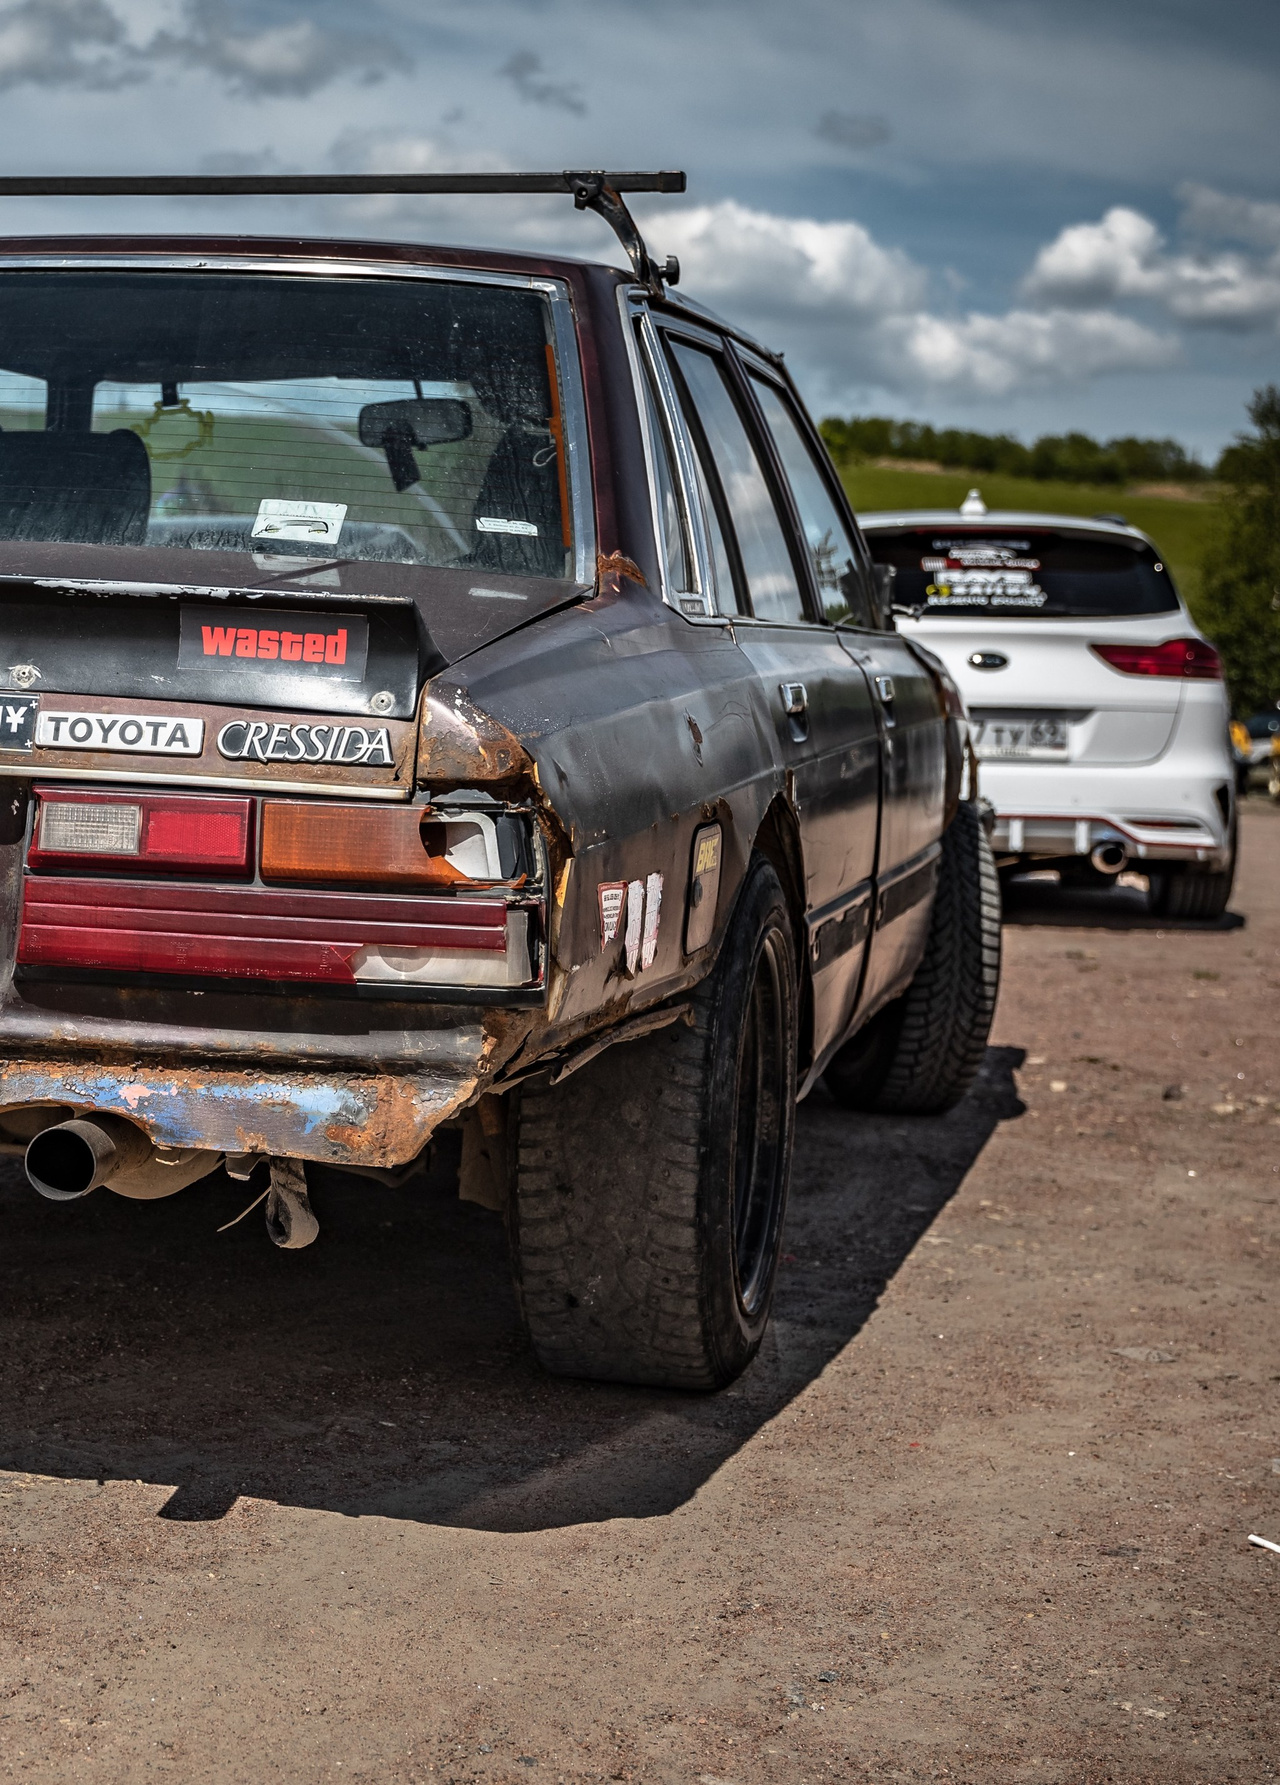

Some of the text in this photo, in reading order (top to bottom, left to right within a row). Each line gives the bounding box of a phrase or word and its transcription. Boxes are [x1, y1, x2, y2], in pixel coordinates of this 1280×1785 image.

[201, 625, 347, 664] Wasted
[47, 716, 191, 748] TOYOTA
[216, 720, 396, 766] CRESSIDA
